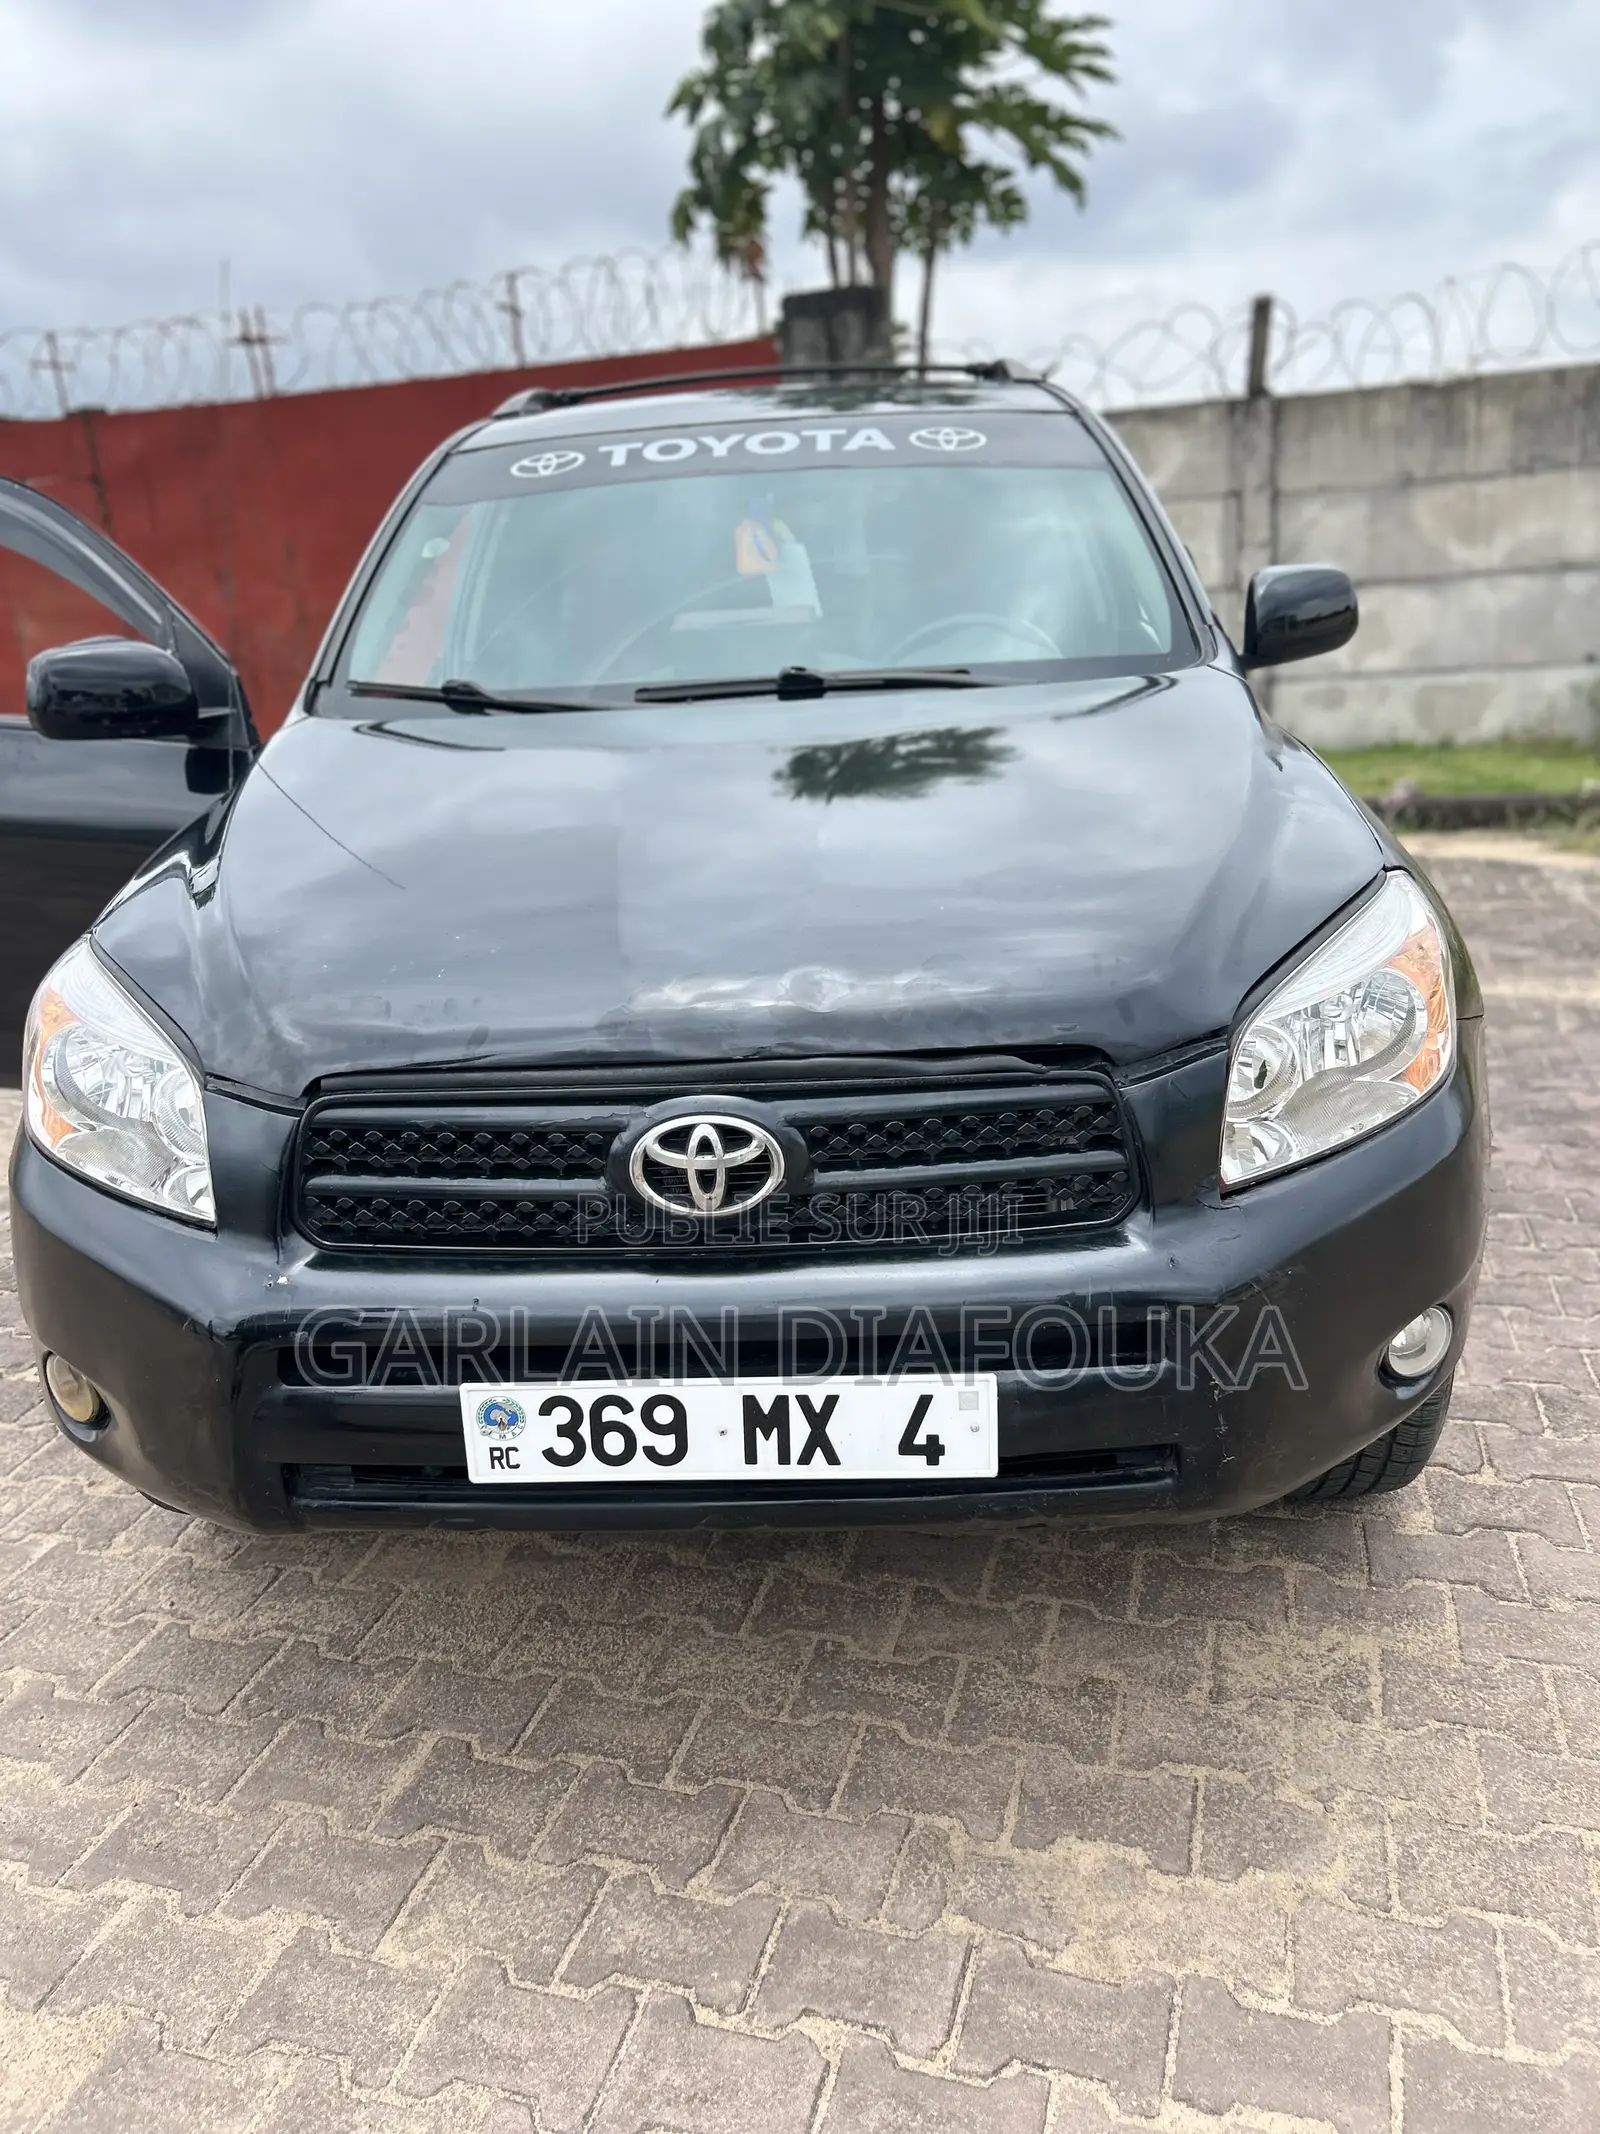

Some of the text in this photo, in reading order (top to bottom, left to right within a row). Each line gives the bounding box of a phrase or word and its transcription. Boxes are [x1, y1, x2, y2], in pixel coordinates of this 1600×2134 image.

[598, 427, 897, 467] TOYOTA
[538, 1394, 946, 1467] 369 MX 4
[489, 1446, 521, 1470] RC
